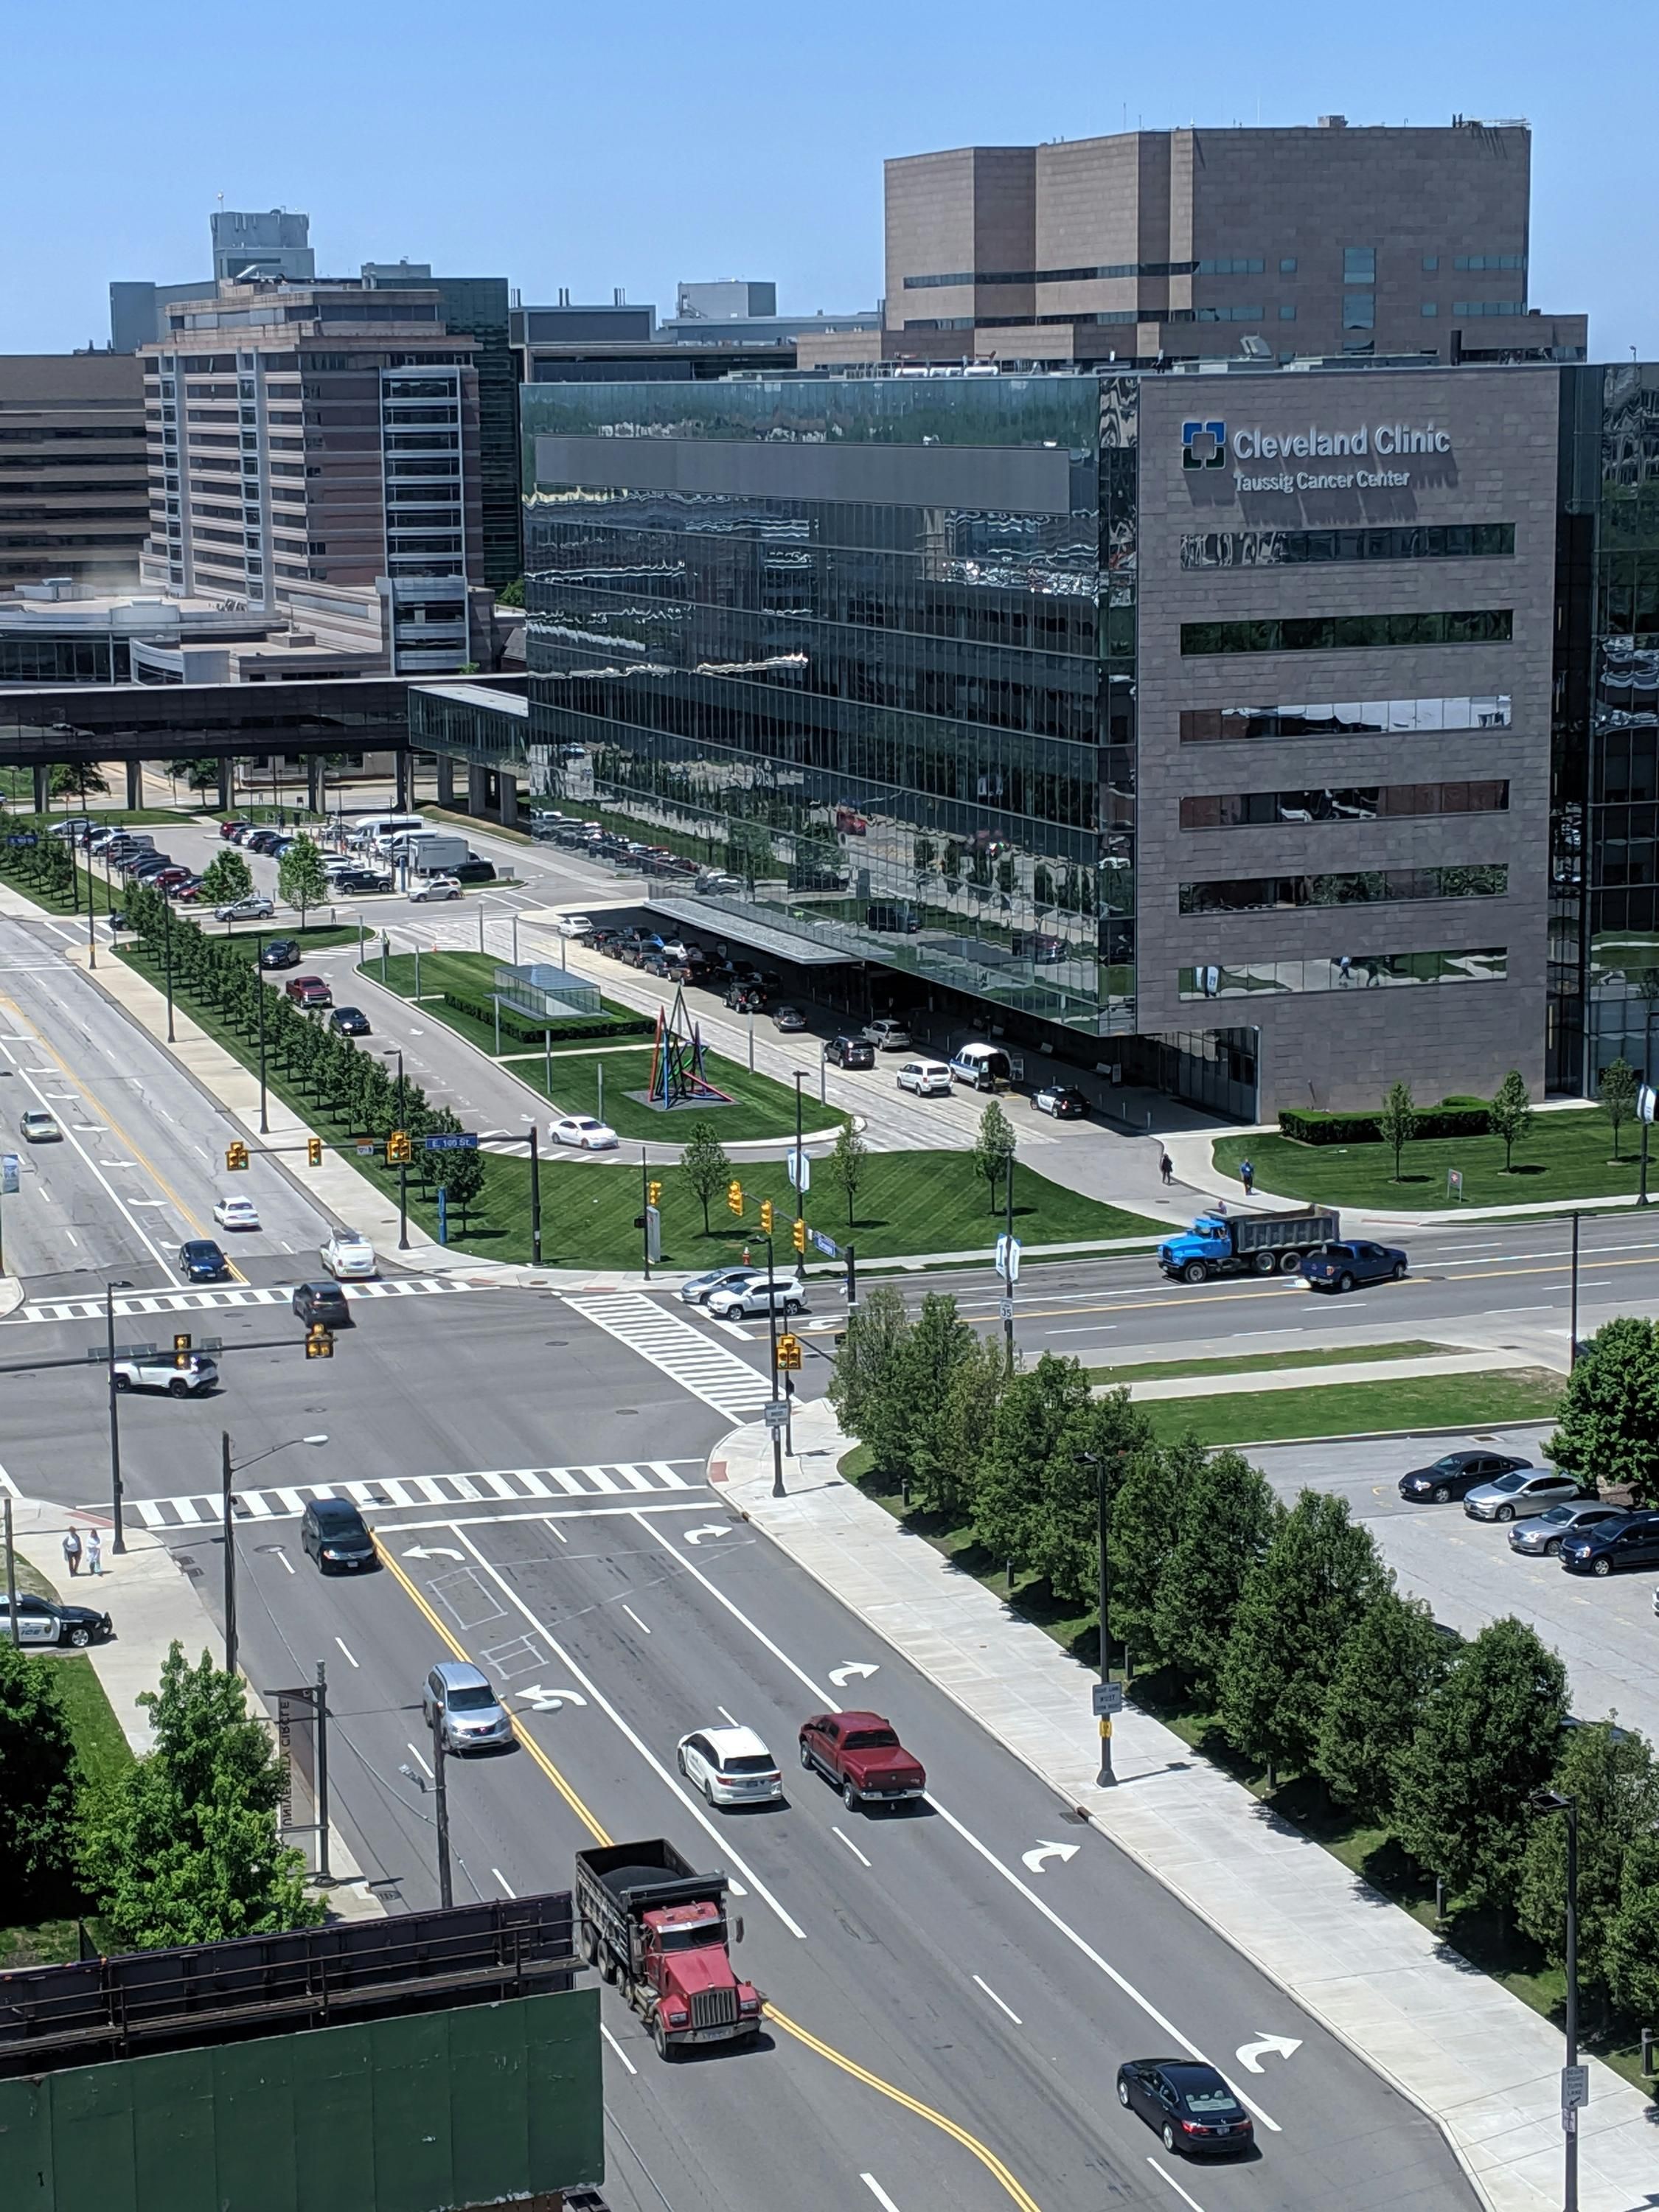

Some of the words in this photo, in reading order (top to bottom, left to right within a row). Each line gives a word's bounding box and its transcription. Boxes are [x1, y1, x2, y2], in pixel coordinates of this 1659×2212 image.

[1234, 425, 1367, 459] Cleveland
[1374, 422, 1451, 455] Clinic
[1234, 470, 1293, 493] Taussig
[1296, 470, 1354, 490] Cancer
[1356, 469, 1411, 487] Center
